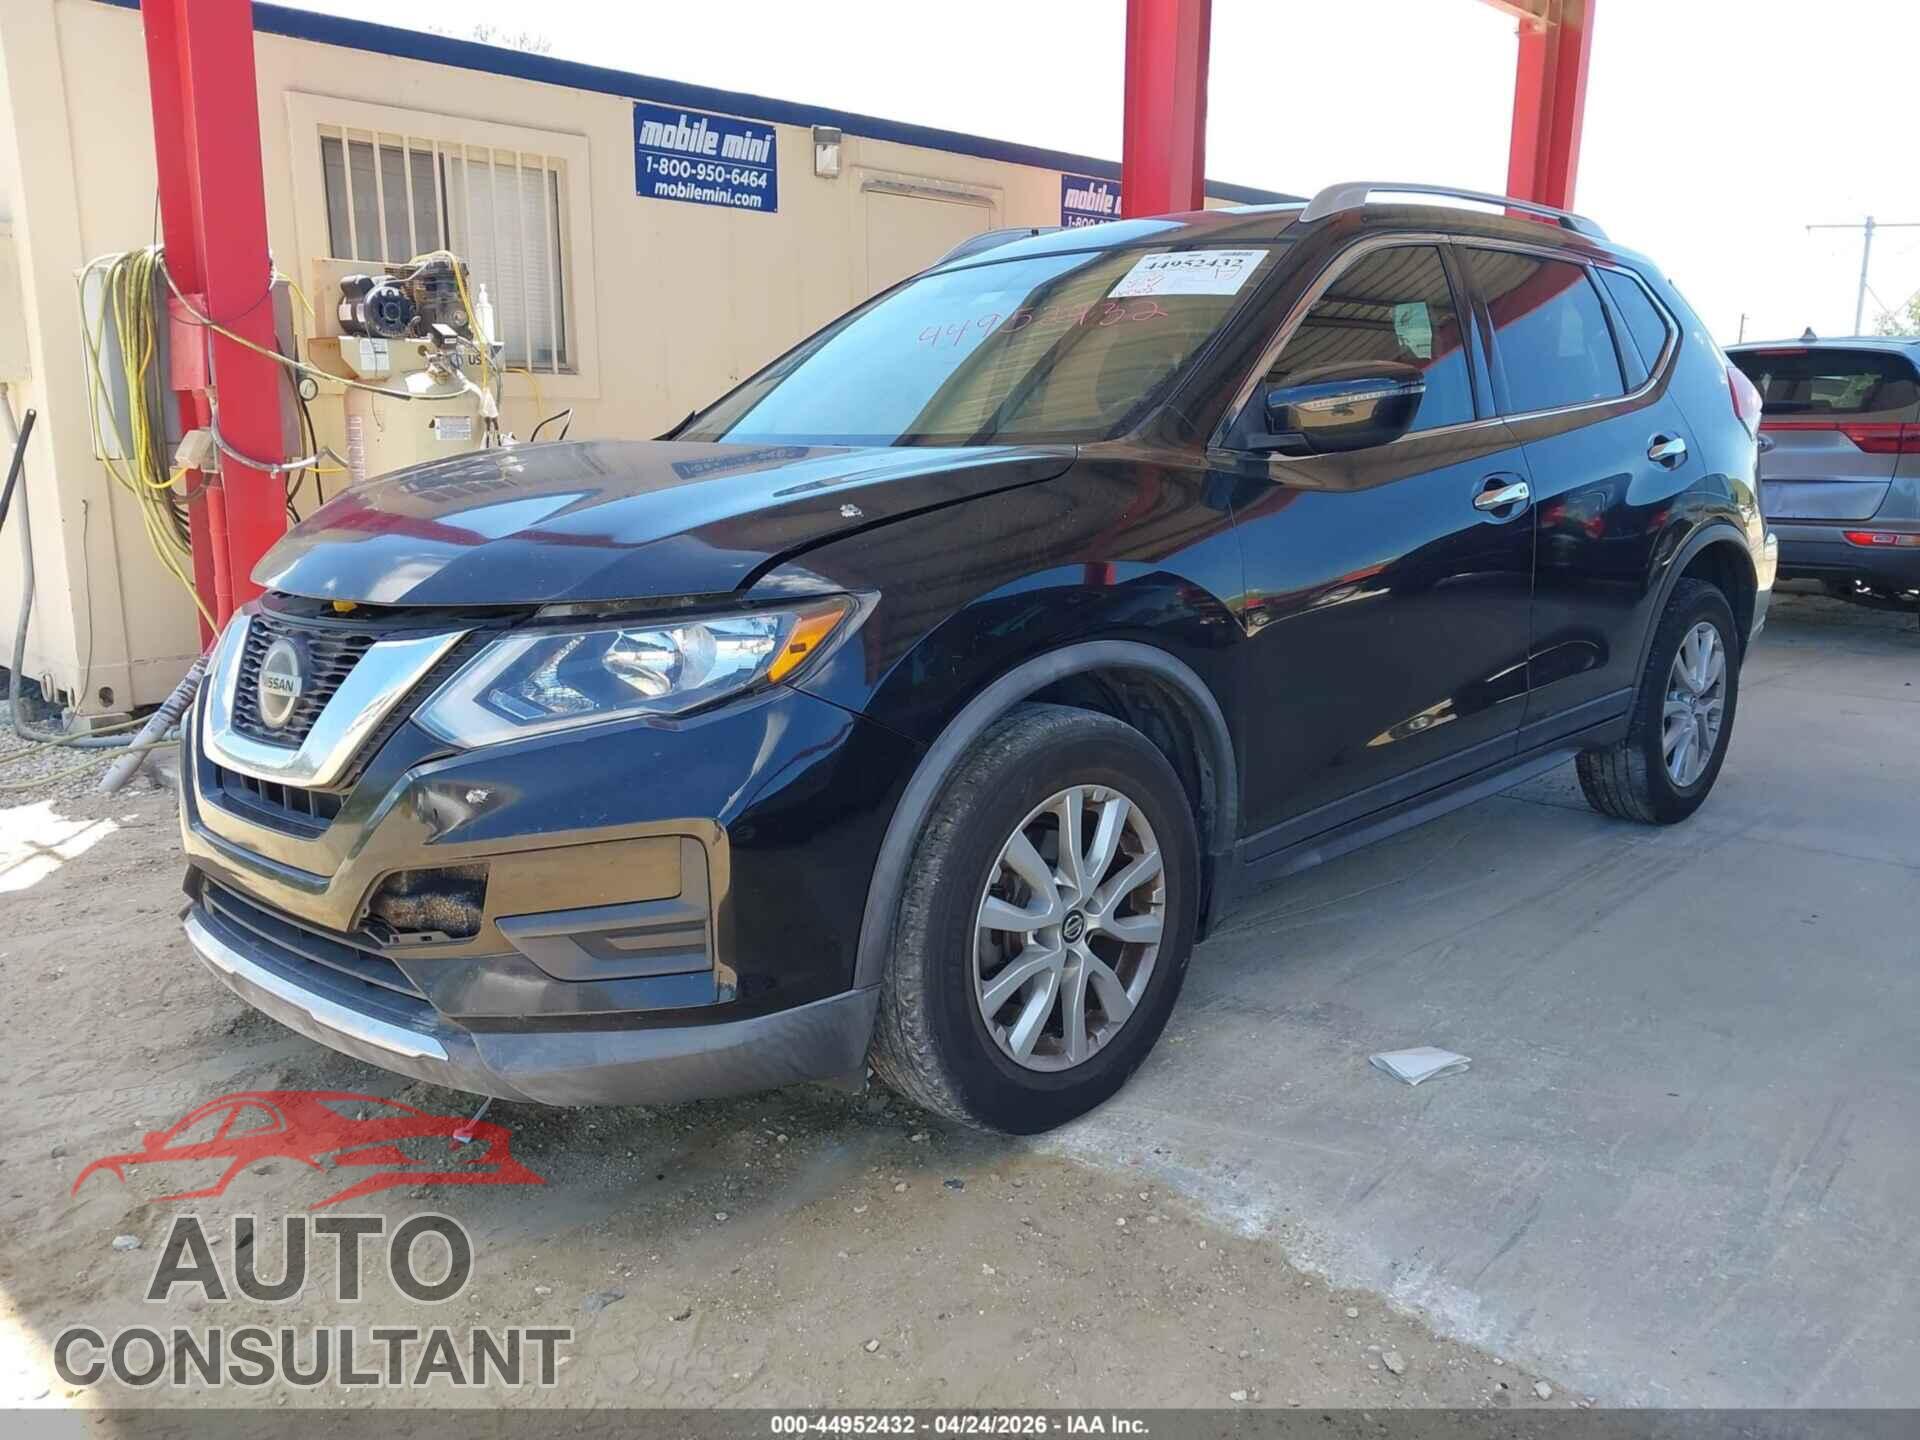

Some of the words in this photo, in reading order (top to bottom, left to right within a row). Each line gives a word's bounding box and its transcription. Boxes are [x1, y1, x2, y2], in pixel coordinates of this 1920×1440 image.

[639, 114, 719, 156] mobile
[721, 131, 772, 163] mini
[646, 156, 767, 189] 1-800-950-6464
[654, 181, 762, 208] mobilemini.com
[1064, 182, 1114, 214] mobile
[262, 676, 294, 692] SSAN
